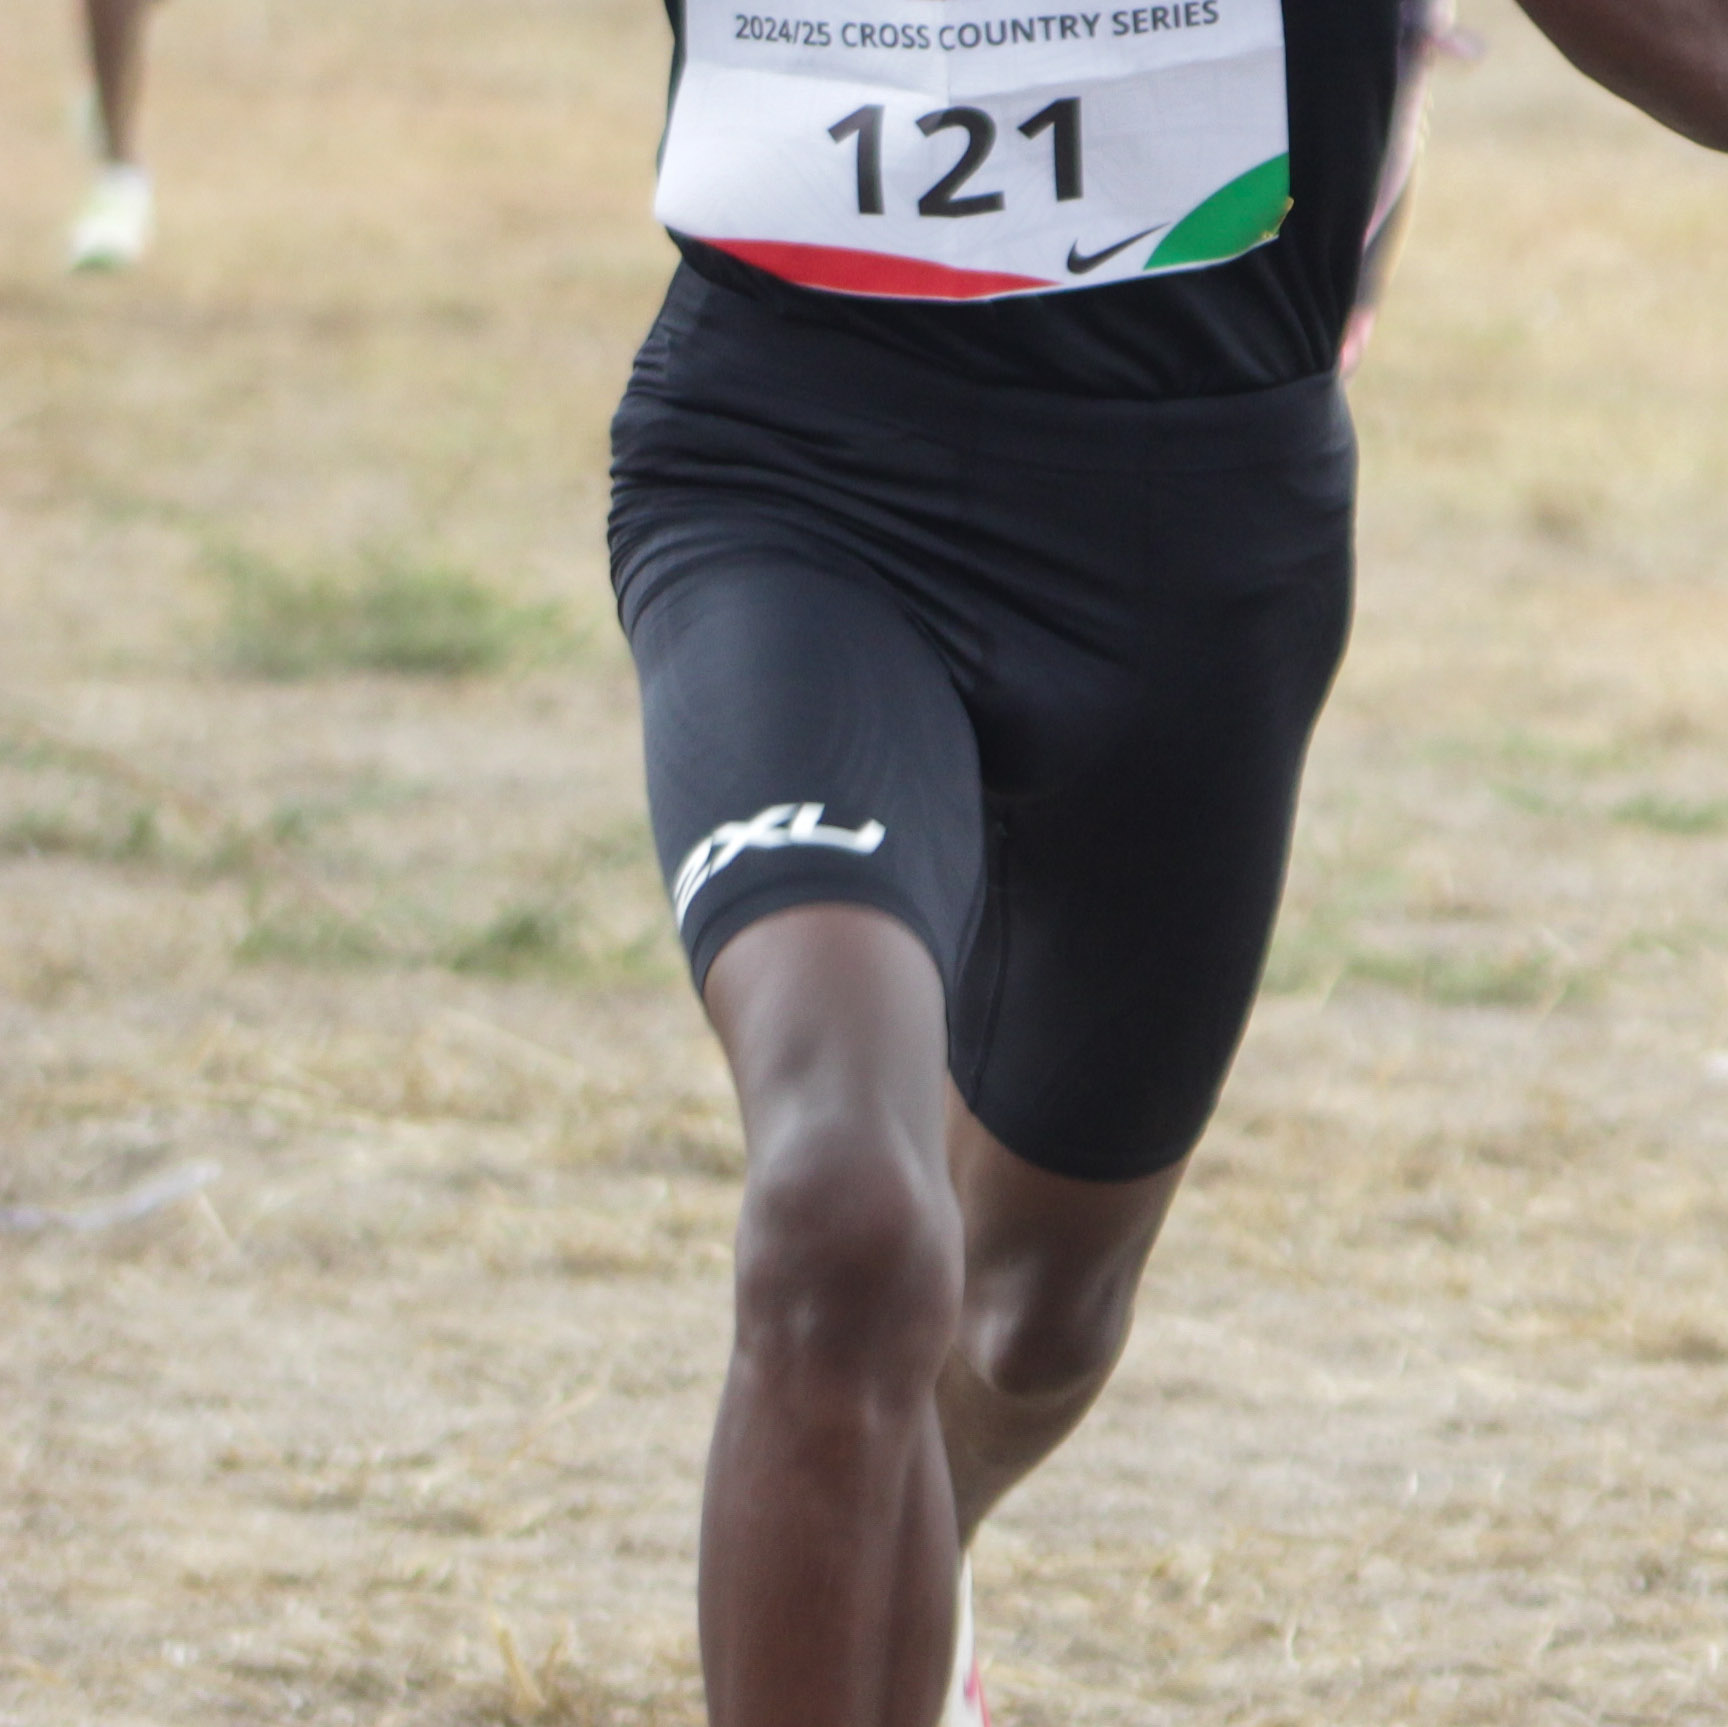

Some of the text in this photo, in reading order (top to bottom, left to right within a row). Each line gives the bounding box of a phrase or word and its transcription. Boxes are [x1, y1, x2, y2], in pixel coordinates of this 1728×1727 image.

[734, 0, 1220, 51] 2024/25 CROSS COUNTRY SERIES
[826, 97, 1084, 217] 121
